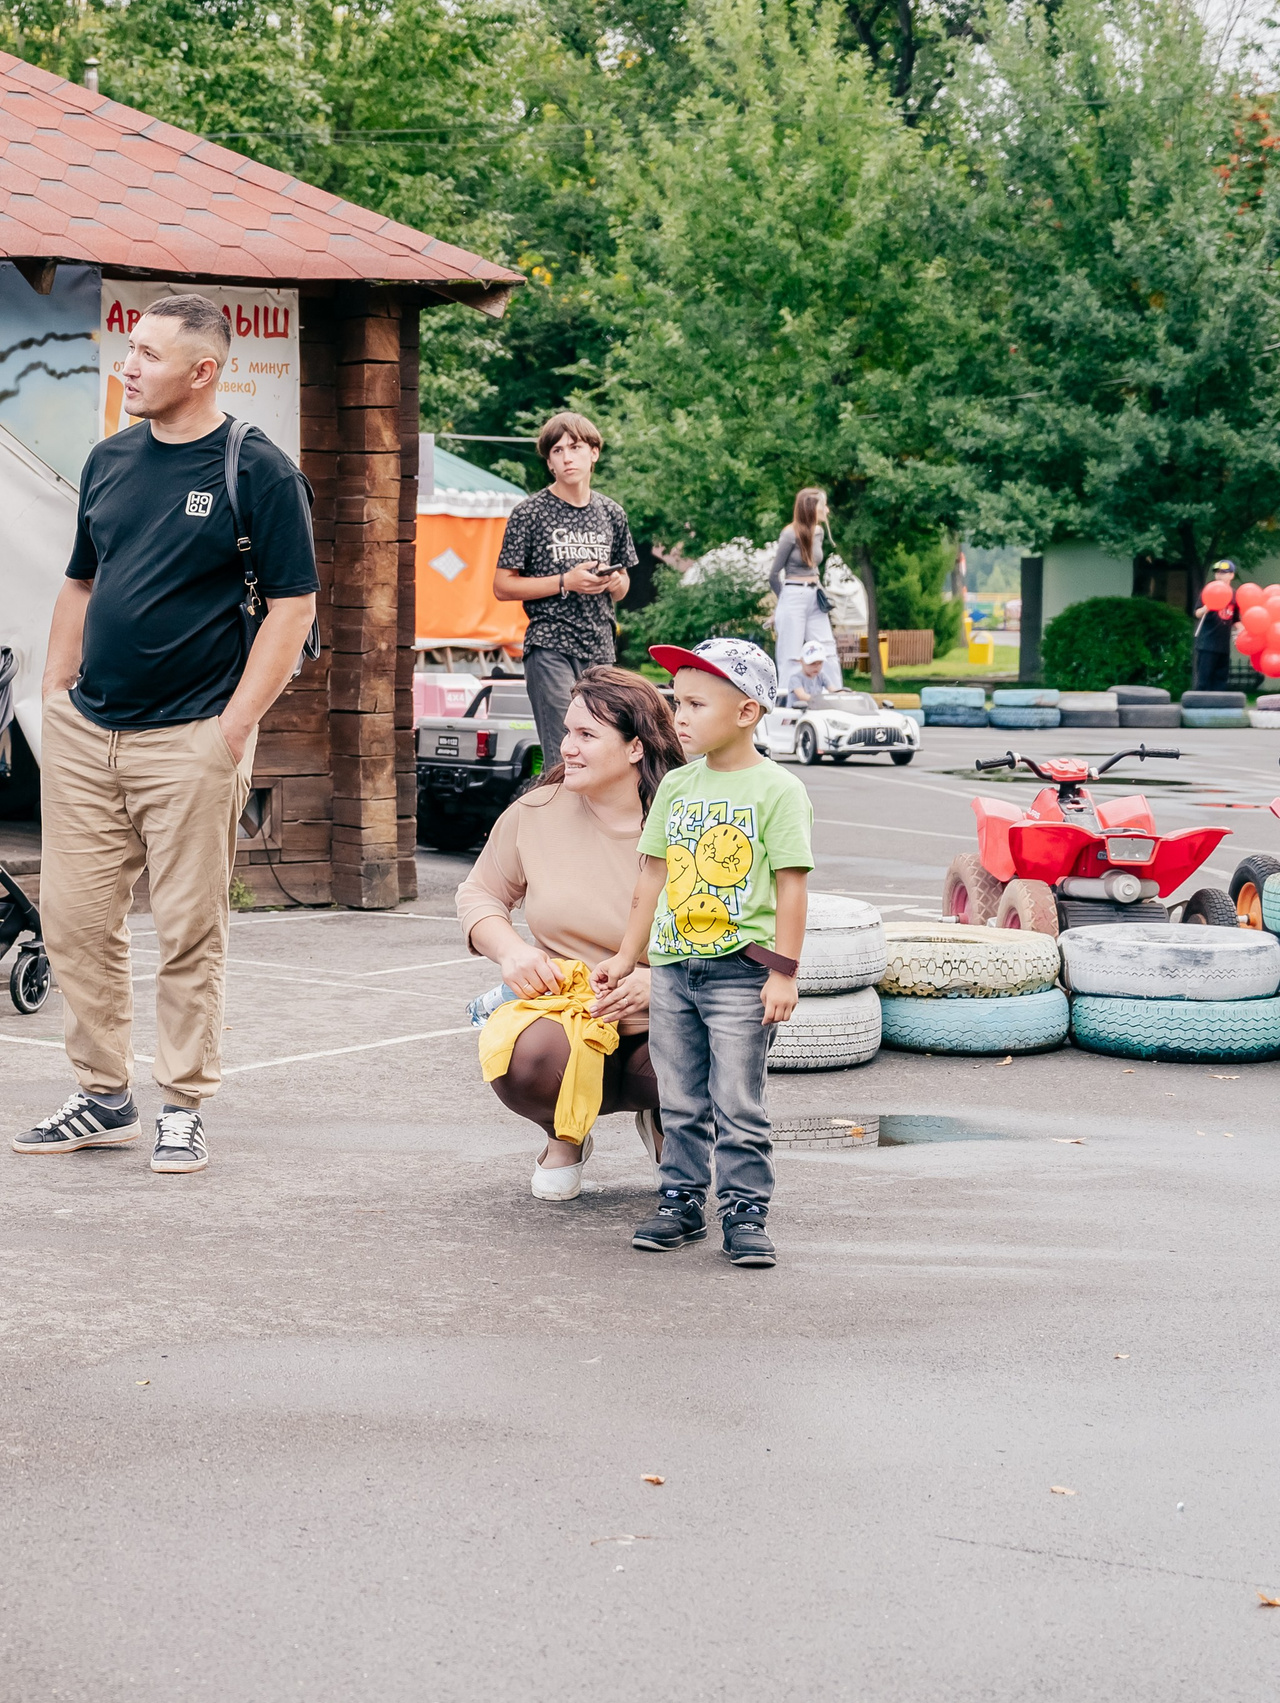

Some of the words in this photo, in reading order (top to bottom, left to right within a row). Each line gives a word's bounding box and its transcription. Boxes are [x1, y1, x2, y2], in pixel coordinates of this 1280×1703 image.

[231, 357, 239, 372] 5
[249, 361, 290, 379] минут
[217, 380, 257, 396] овека)
[552, 528, 596, 544] GAME
[546, 543, 610, 562] THRONES
